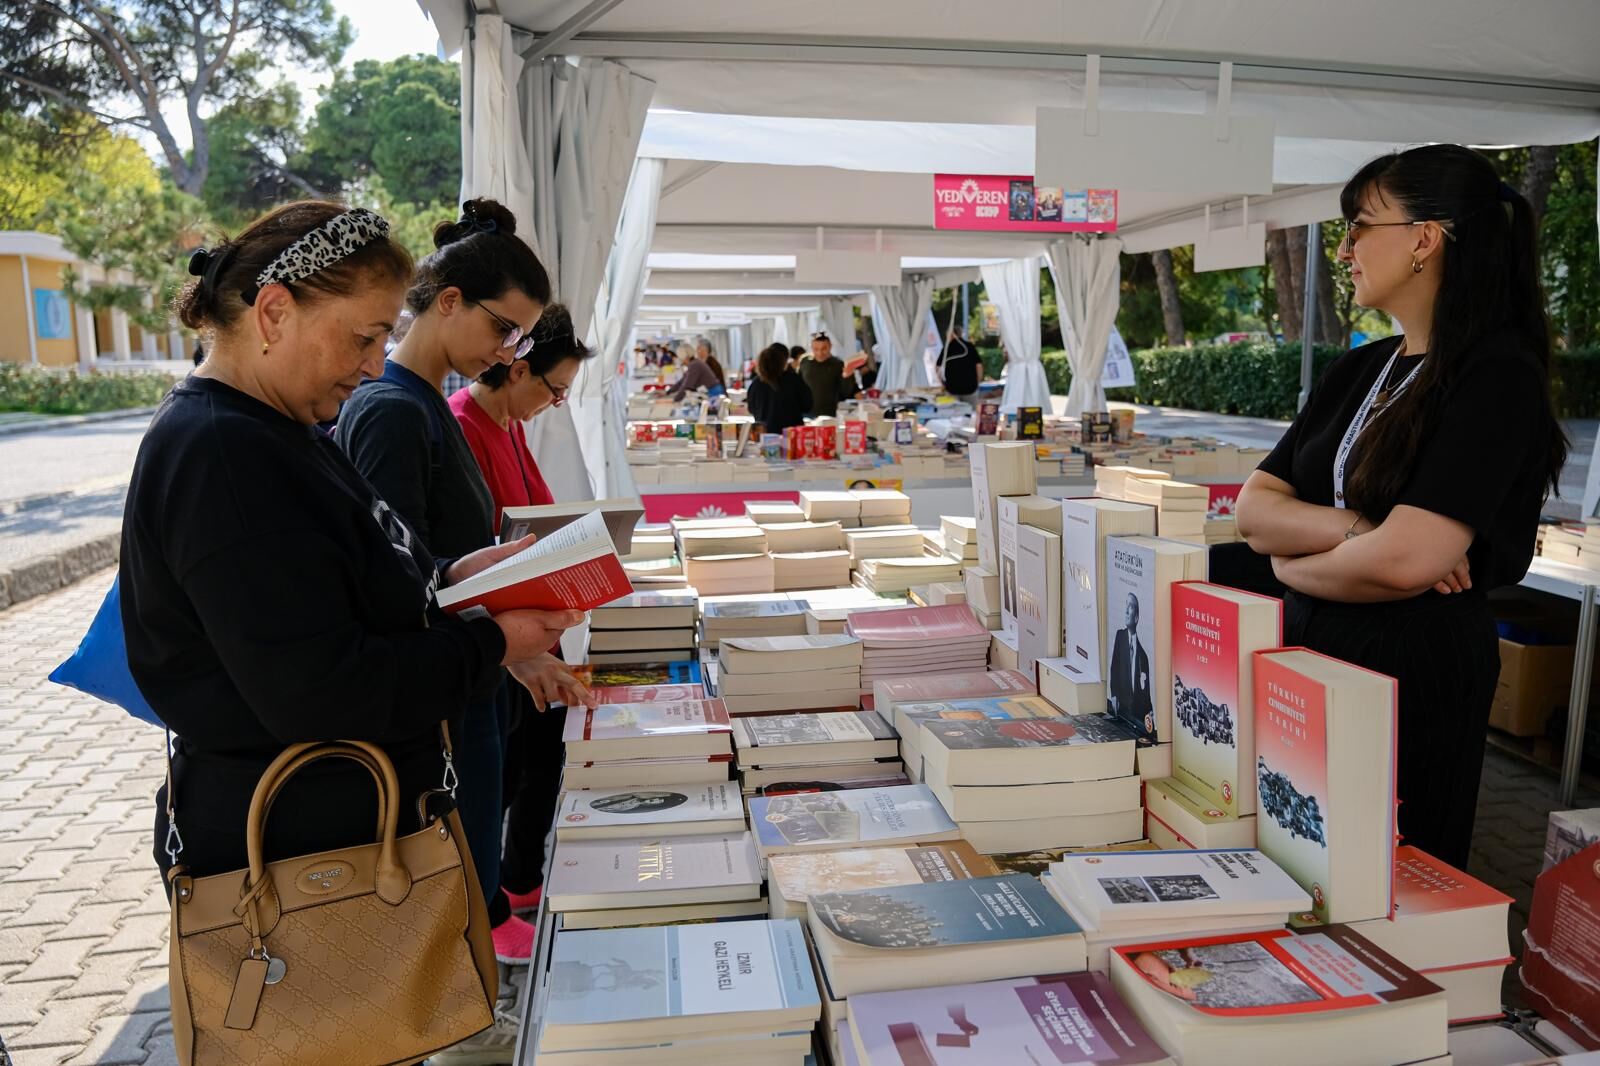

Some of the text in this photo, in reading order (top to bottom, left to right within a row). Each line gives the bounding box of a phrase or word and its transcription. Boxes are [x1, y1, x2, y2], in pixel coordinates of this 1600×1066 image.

[1185, 607, 1221, 627] TÜRKİYE
[1185, 633, 1220, 656] TARİHİ
[714, 940, 734, 991] GAZİ HEYKELİ
[737, 951, 753, 975] İZMİR
